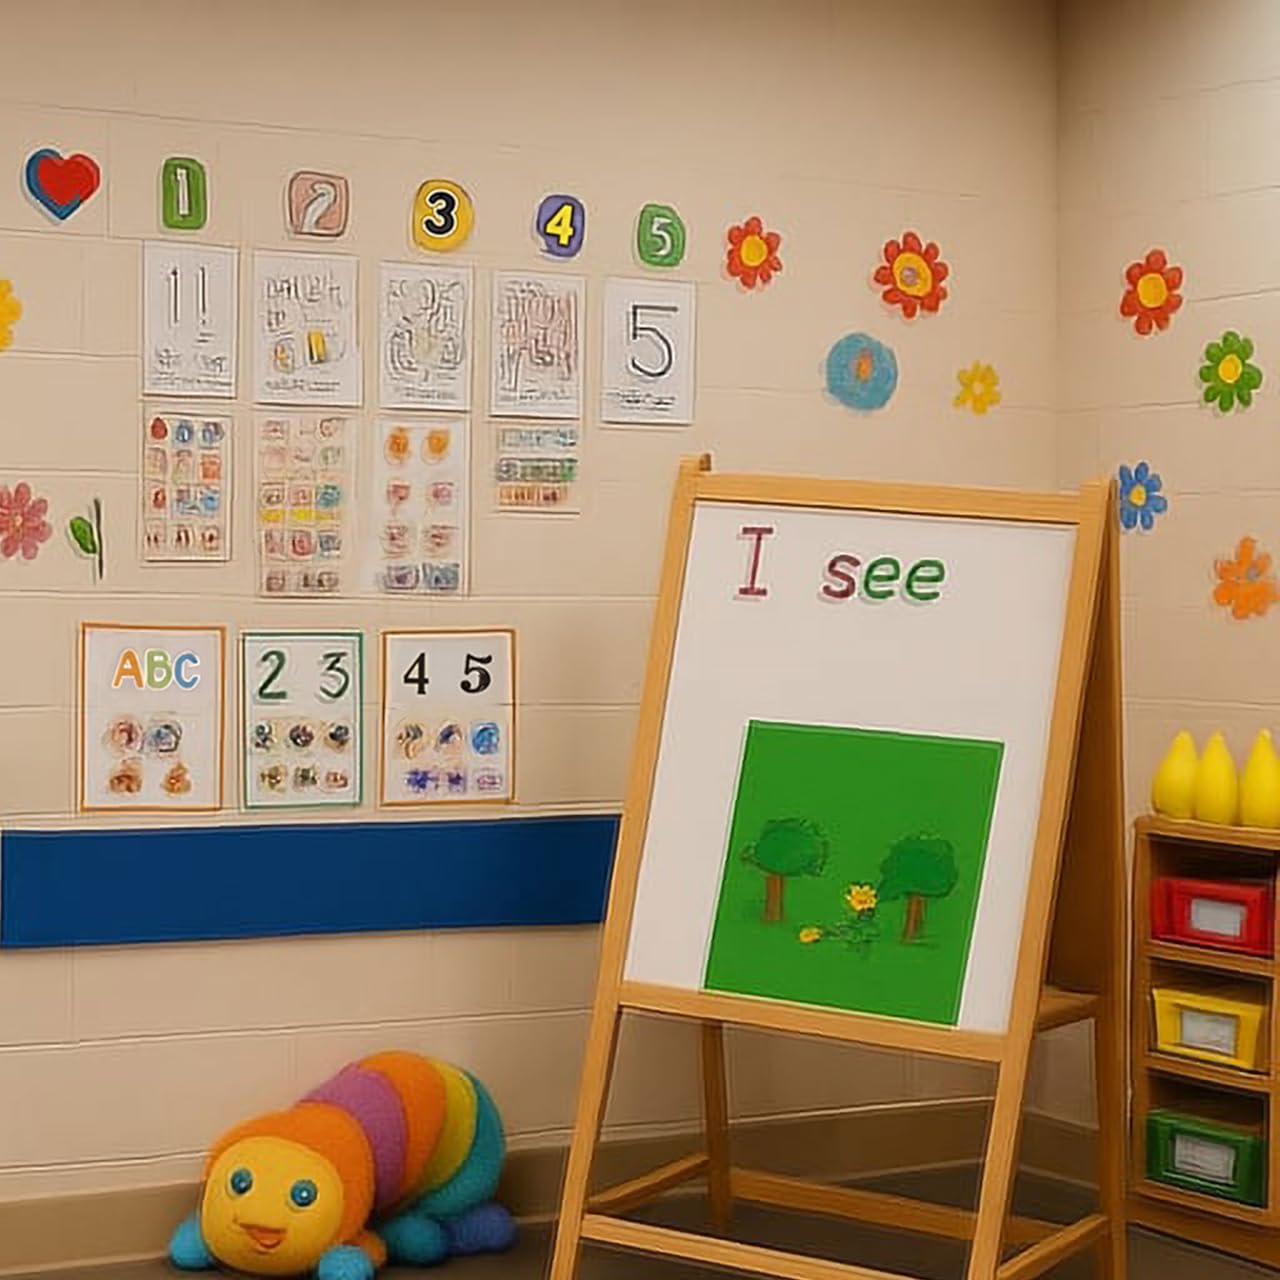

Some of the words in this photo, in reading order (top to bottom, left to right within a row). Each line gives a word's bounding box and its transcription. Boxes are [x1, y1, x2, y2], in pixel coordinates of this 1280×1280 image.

[421, 190, 457, 237] 3
[544, 204, 574, 247] 4
[647, 218, 676, 256] 5
[630, 304, 678, 376] 5
[740, 527, 774, 597] I
[822, 552, 945, 601] see
[112, 648, 200, 689] ABC
